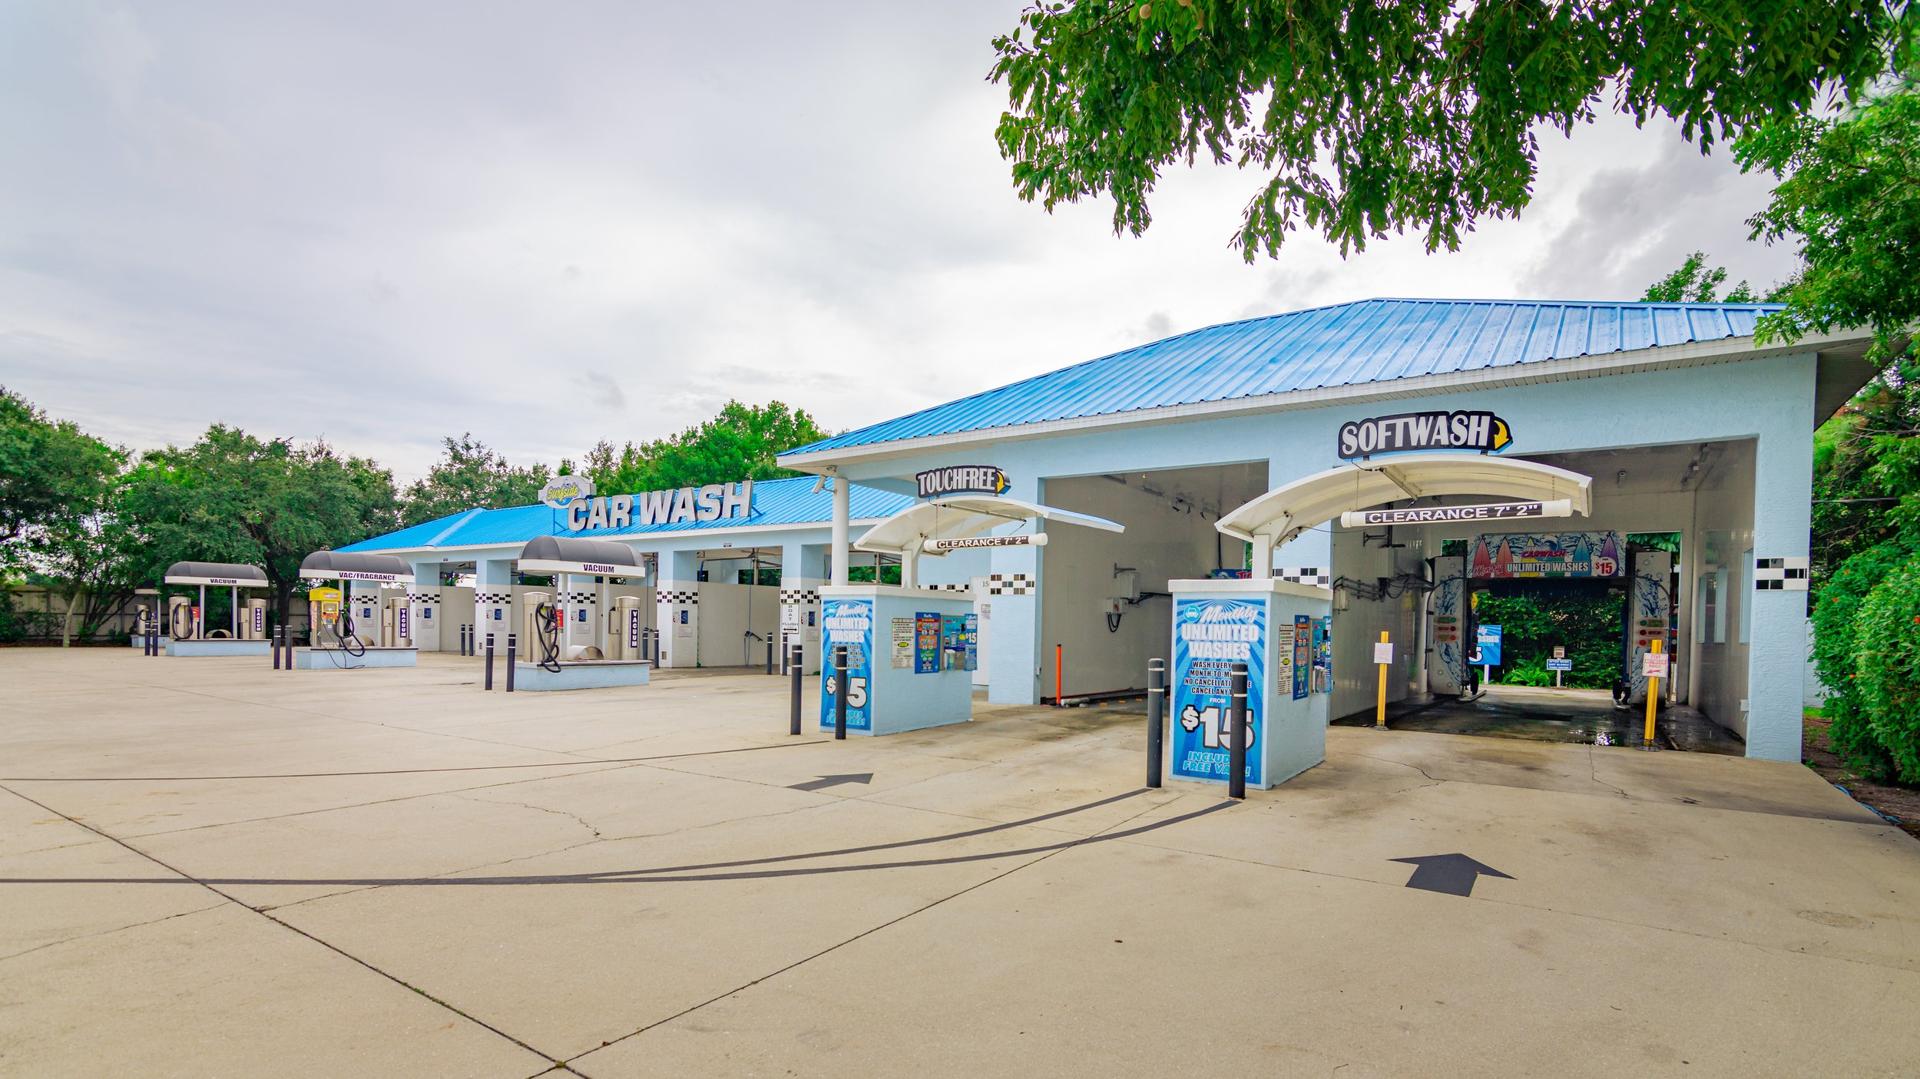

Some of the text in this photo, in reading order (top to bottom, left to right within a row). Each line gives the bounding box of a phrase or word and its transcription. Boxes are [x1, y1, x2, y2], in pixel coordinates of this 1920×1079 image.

[1342, 415, 1491, 455] SOFTWASH
[918, 468, 996, 495] TOUCHFREE
[567, 480, 754, 532] CAR WASH
[1368, 507, 1489, 523] CLEARANCE
[938, 538, 1002, 549] CLEARANCE
[339, 572, 396, 581] VAC/FRAGRANCE
[583, 563, 615, 574] VACUUM
[1507, 563, 1550, 572] UNLIMITED
[1552, 562, 1589, 572] WASHES
[1595, 562, 1613, 575] $15
[1200, 604, 1258, 624] Monthly
[1181, 623, 1260, 642] UNLIMITED
[1188, 641, 1251, 660] WASHES
[1193, 661, 1232, 669] WASH EVERY
[1194, 679, 1232, 687] CANCELLATI
[826, 675, 868, 709] $5
[1181, 704, 1256, 752] $15
[1187, 751, 1231, 764] INCLUD
[1182, 760, 1212, 773] FREE
